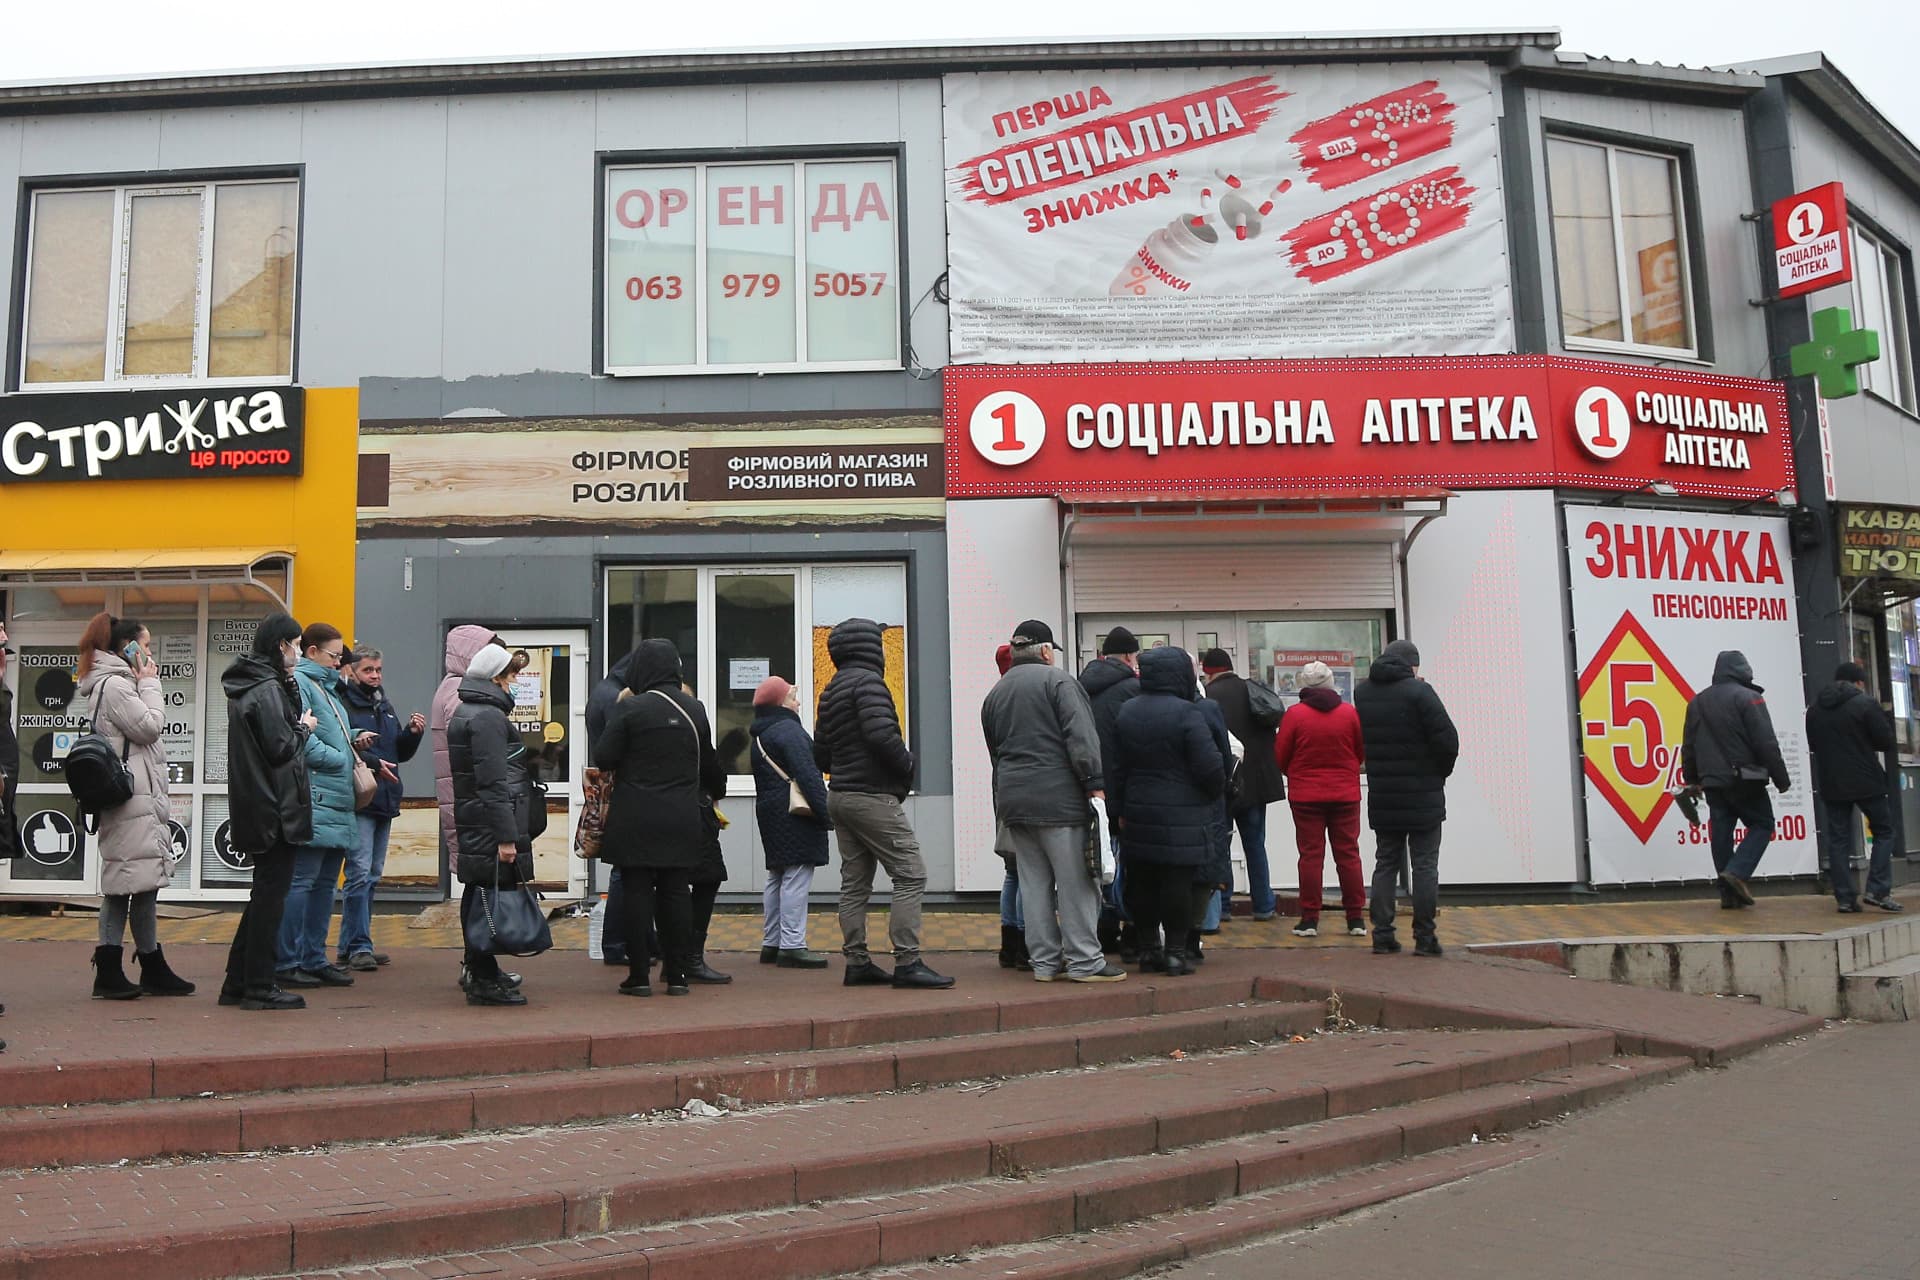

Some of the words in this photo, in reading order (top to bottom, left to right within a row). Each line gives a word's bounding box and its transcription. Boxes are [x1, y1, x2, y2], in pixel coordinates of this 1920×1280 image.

[991, 86, 1112, 138] ПЕРША
[978, 96, 1245, 197] СПЕЦІАЛЬНА
[1326, 141, 1353, 158] ВІД
[1315, 246, 1335, 261] ДО
[1779, 238, 1838, 268] СОЦІАЛЬНА
[1136, 244, 1191, 294] ЗНИЖКИ
[1791, 257, 1829, 280] АПТЕКА
[625, 275, 683, 301] 063
[723, 273, 781, 298] 979
[814, 272, 887, 297] 5057
[1066, 400, 1335, 455] СОЦІАЛЬНА
[1361, 396, 1538, 443] АПТЕКА
[1635, 391, 1769, 434] СОЦІАЛЬНА
[1, 389, 289, 477] Стрижка
[190, 450, 216, 469] це
[220, 448, 291, 470] просто
[727, 452, 833, 471] ФІРМОВИЙ
[838, 453, 929, 469] МАГАЗИН
[1664, 432, 1751, 470] АПТЕКА
[572, 482, 689, 504] РОЗЛИ
[727, 474, 860, 490] РОЗЛИВНОГО
[865, 473, 917, 488] ПИВА
[1847, 510, 1920, 530] КАВА
[1845, 532, 1899, 545] НАПОЇ
[1585, 520, 1785, 585] ЗНИЖКА
[1653, 593, 1788, 622] ПЕНСІОНЕРАМ
[44, 697, 64, 707] грн.
[42, 761, 63, 772] грн.
